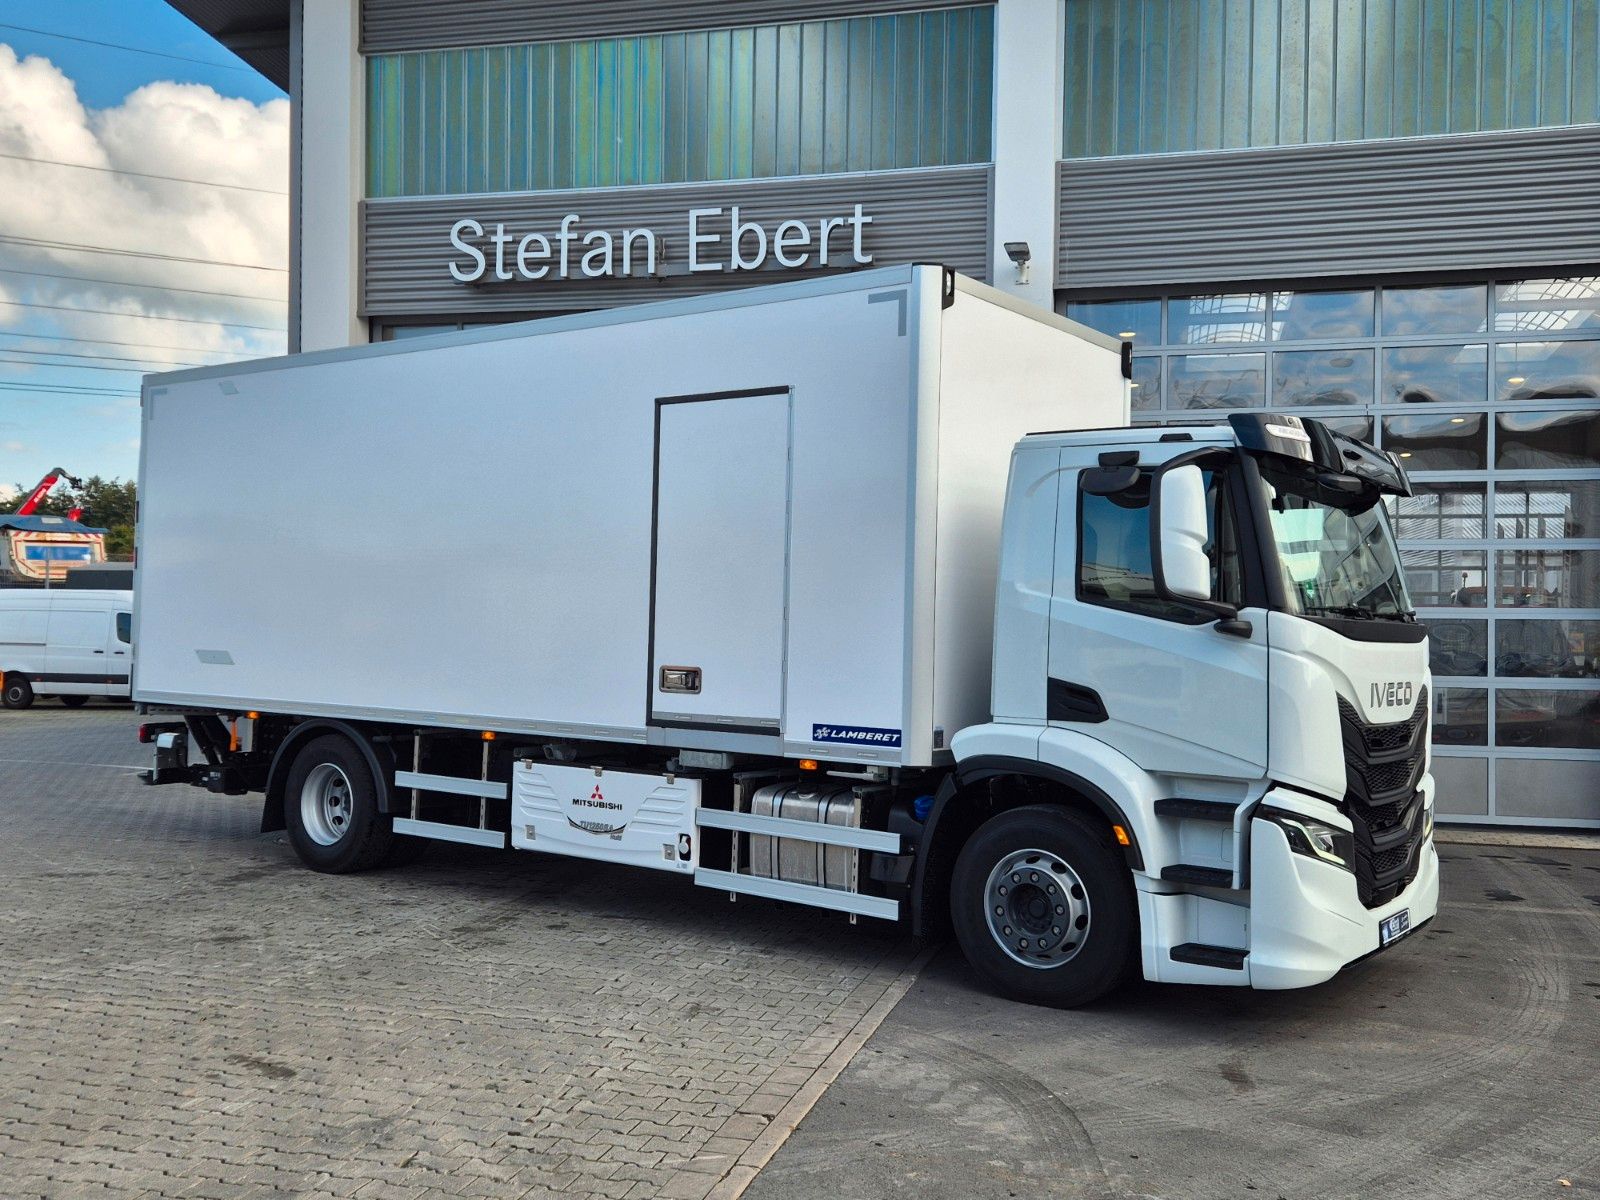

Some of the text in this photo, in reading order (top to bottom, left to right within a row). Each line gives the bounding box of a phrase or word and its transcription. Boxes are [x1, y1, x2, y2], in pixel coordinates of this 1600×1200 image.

[448, 203, 873, 283] Stefan Ebert
[1370, 681, 1412, 708] IVECO
[830, 729, 901, 742] LAMBERET
[572, 798, 623, 811] MITSUBISHI
